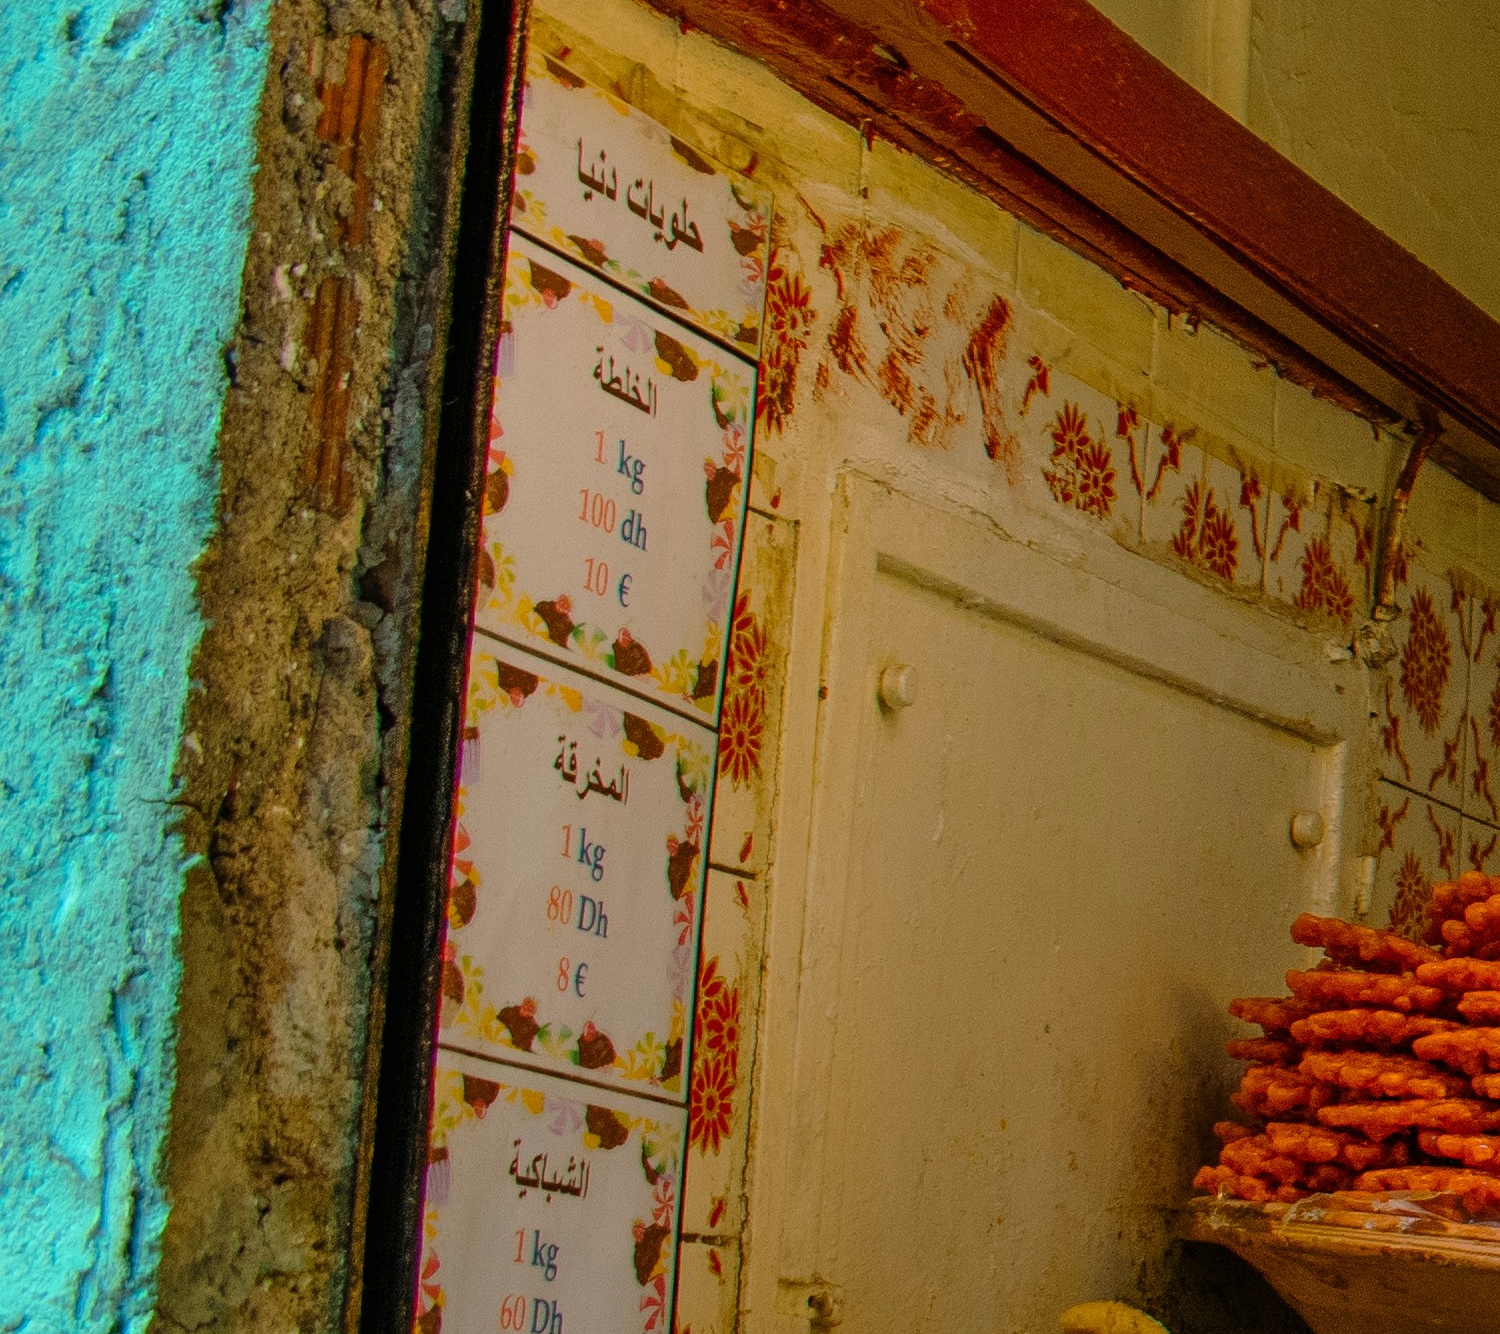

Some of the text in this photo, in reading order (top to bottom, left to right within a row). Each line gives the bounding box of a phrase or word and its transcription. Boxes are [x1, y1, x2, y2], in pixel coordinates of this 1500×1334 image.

[577, 136, 704, 253] حلويات دنيا
[593, 345, 659, 419] الخلطة
[594, 430, 647, 495] 1 kg
[579, 487, 648, 551] 100 dh
[583, 557, 633, 608] 10 €
[554, 734, 631, 806] المخرقة
[561, 823, 606, 882] 1 kg
[547, 885, 609, 939] 80 Dh
[557, 957, 589, 998] 8 €
[509, 1138, 591, 1204] الشباكية
[513, 1227, 560, 1282] 1 kg
[500, 1293, 527, 1333] 60
